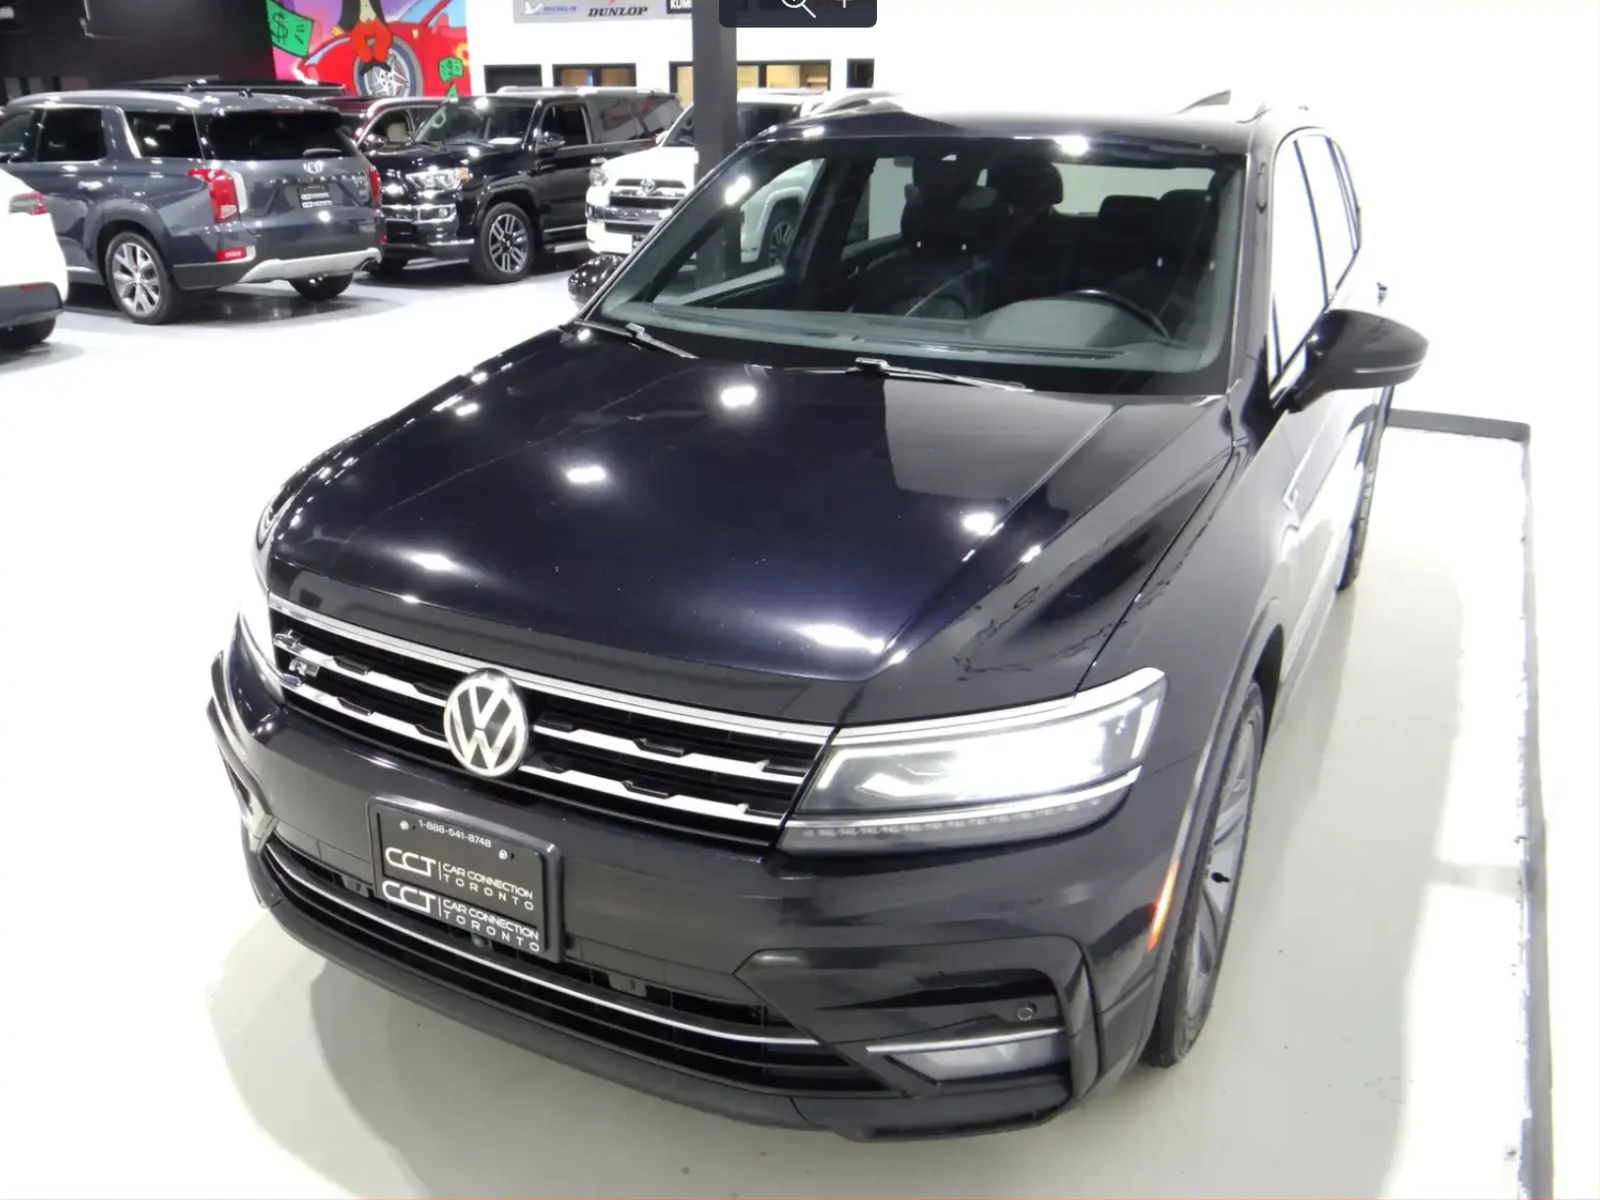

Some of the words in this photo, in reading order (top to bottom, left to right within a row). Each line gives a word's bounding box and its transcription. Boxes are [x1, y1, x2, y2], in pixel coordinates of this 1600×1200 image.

[588, 6, 648, 18] DUNLOP
[418, 819, 492, 848] 1-888-541-8748
[385, 846, 437, 877] CCT
[382, 880, 437, 914] CCT
[442, 863, 466, 878] CAR
[466, 870, 534, 900] CONNECTION
[443, 873, 534, 911] TORONTO
[442, 899, 467, 915] CAR
[468, 908, 539, 941] CONNECTION
[443, 910, 540, 952] TORONTO
